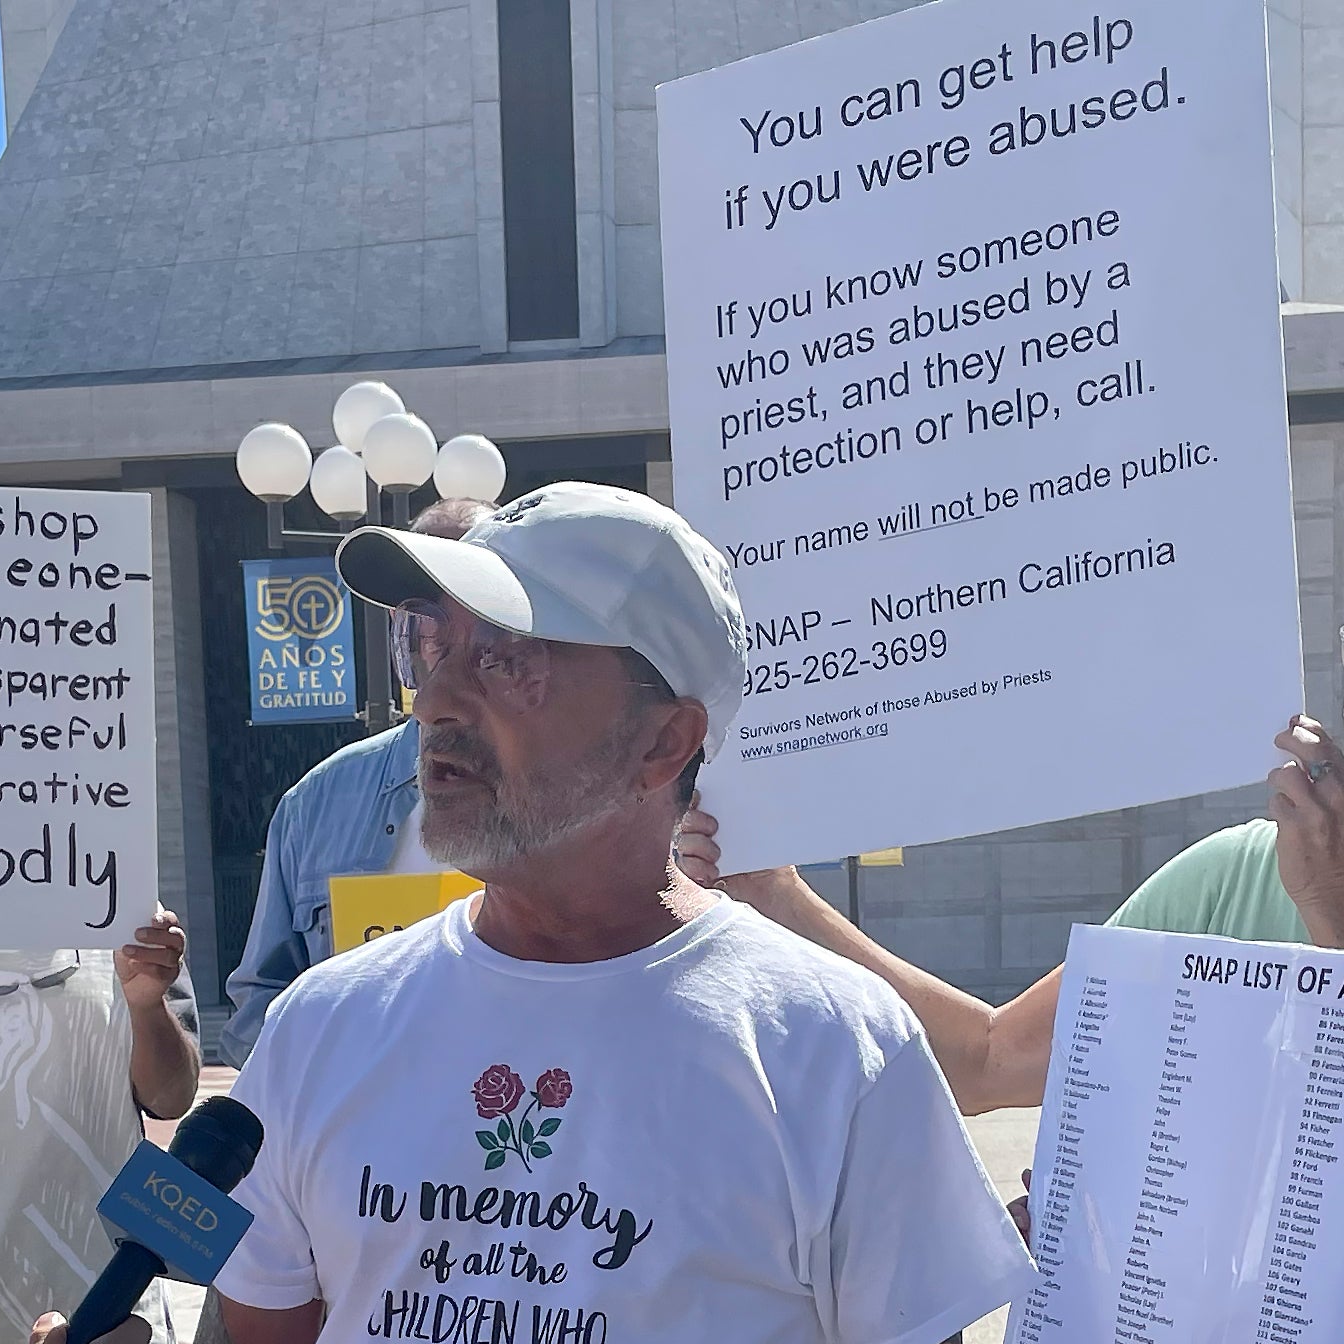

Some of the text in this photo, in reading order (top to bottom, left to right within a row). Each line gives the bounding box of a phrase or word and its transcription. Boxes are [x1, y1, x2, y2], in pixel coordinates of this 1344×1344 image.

[740, 15, 1133, 154] You can get help
[725, 66, 1186, 231] if you were abused.
[716, 210, 1120, 339] If you know someone
[716, 262, 1131, 389] who was abused by a
[721, 312, 1119, 450] priest, and they need
[723, 359, 1155, 501] protection or help, call.
[725, 442, 1218, 571] Your name will not be made public.
[255, 576, 344, 641] 50
[871, 578, 1006, 626] Northern
[1018, 538, 1175, 593] California
[259, 644, 345, 669] AÑOS
[259, 669, 347, 691] DE FE Y
[259, 692, 347, 709] GRATITUD
[740, 669, 1052, 740] Survivors Network of those Abused by Priests
[740, 720, 888, 759] www.snapnetwork.org
[1181, 953, 1238, 985] SNAP
[1242, 960, 1287, 991] LIST
[1297, 965, 1333, 995] OF
[143, 1170, 219, 1232] KQED
[359, 1164, 654, 1270] In memory
[419, 1240, 569, 1286] of all the
